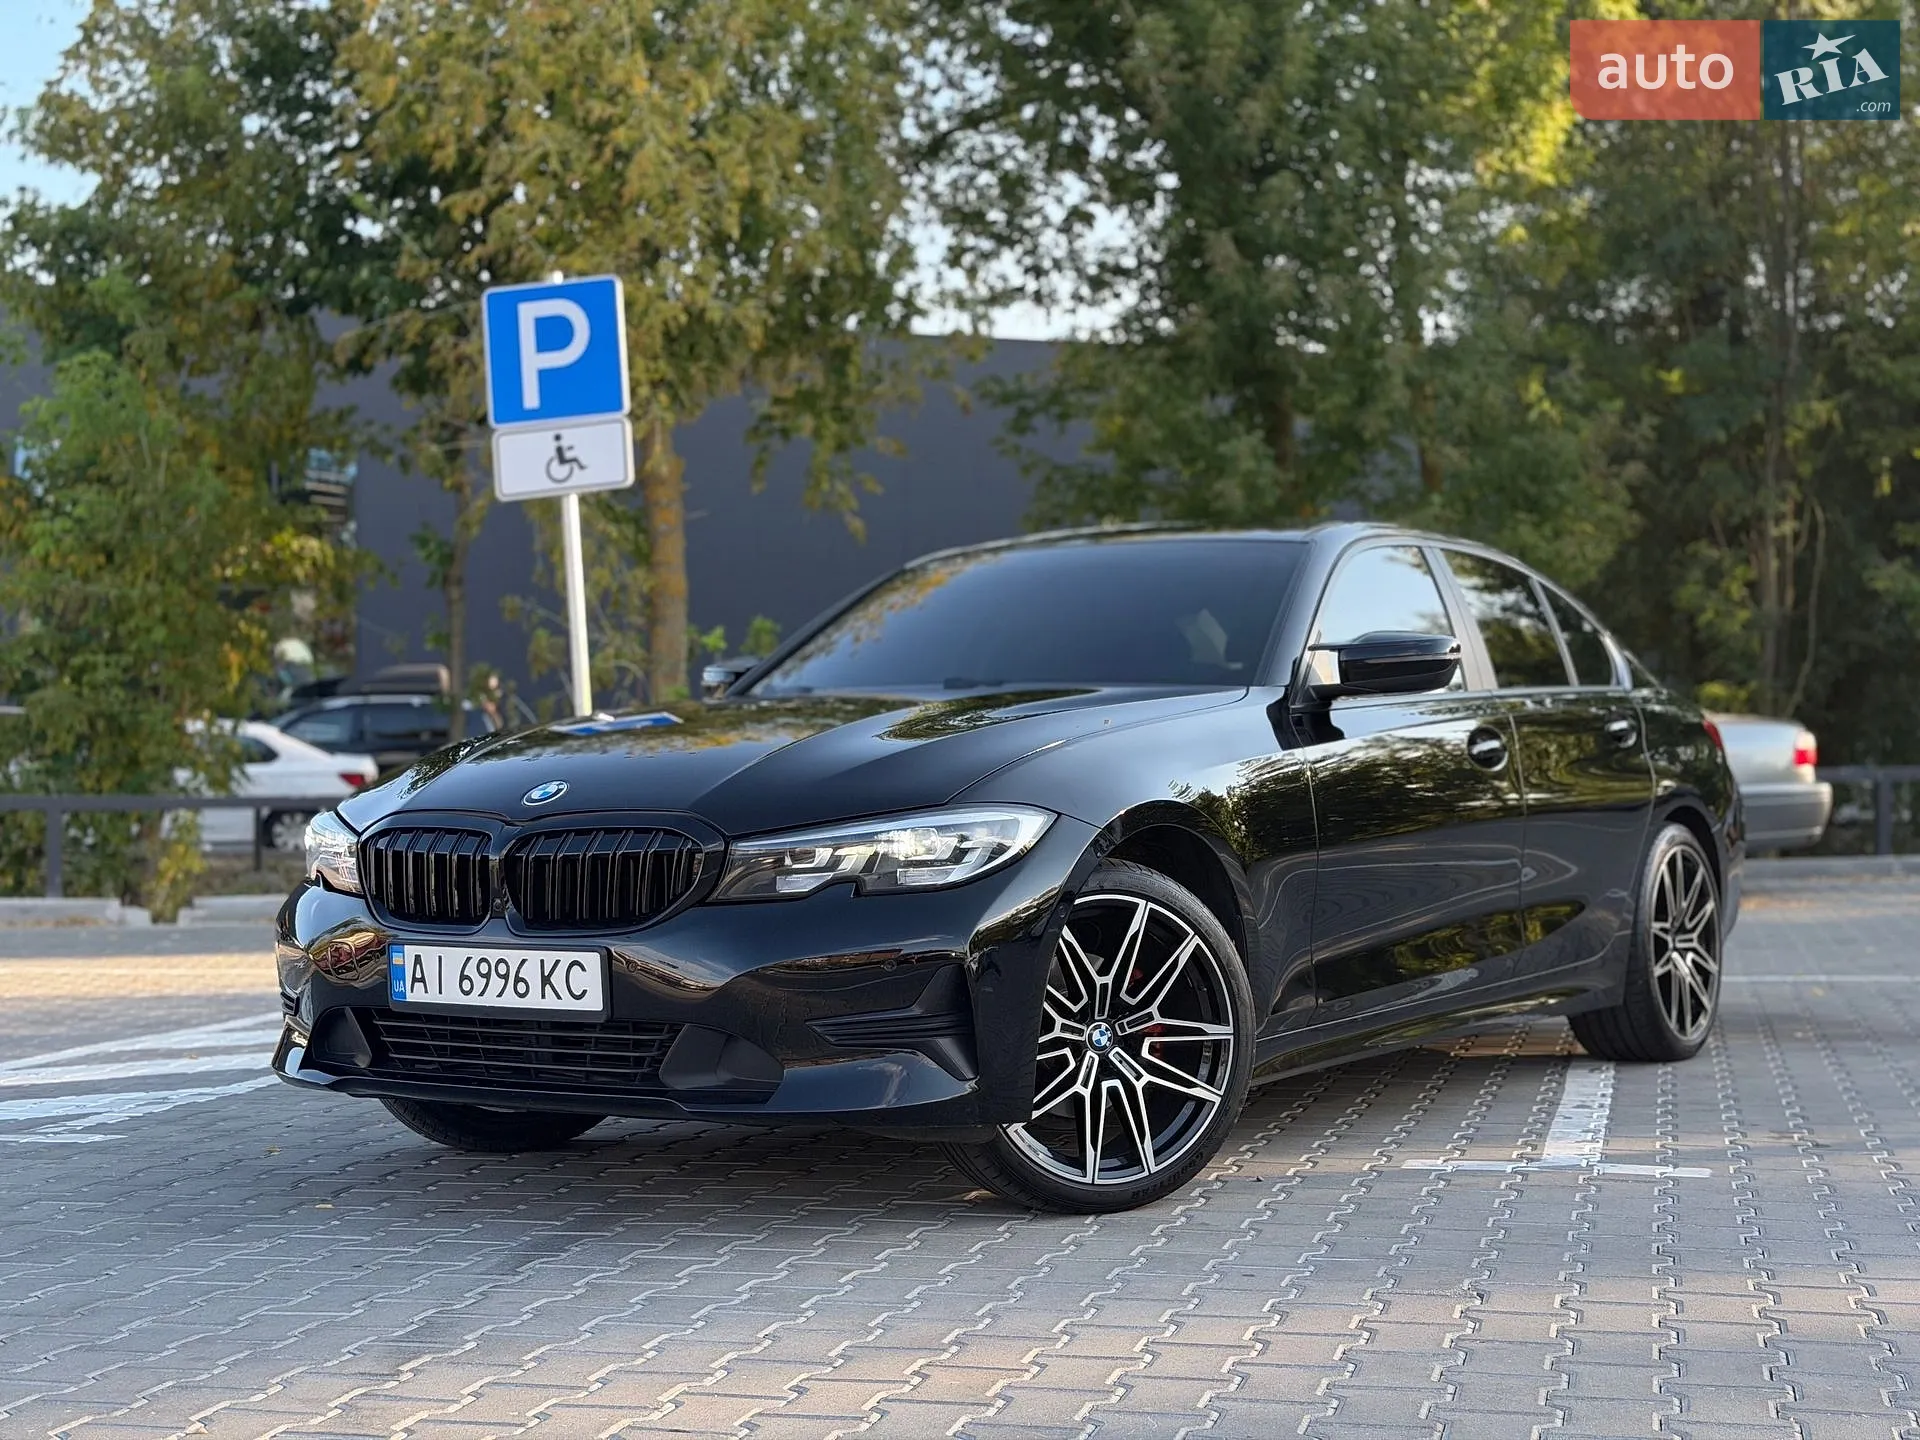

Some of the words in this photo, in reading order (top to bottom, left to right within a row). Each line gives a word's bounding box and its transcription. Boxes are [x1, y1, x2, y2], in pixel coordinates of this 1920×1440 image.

[517, 298, 591, 411] P
[393, 979, 406, 993] UA
[410, 954, 443, 995] AI
[458, 957, 530, 999] 6996
[540, 959, 588, 1001] KC
